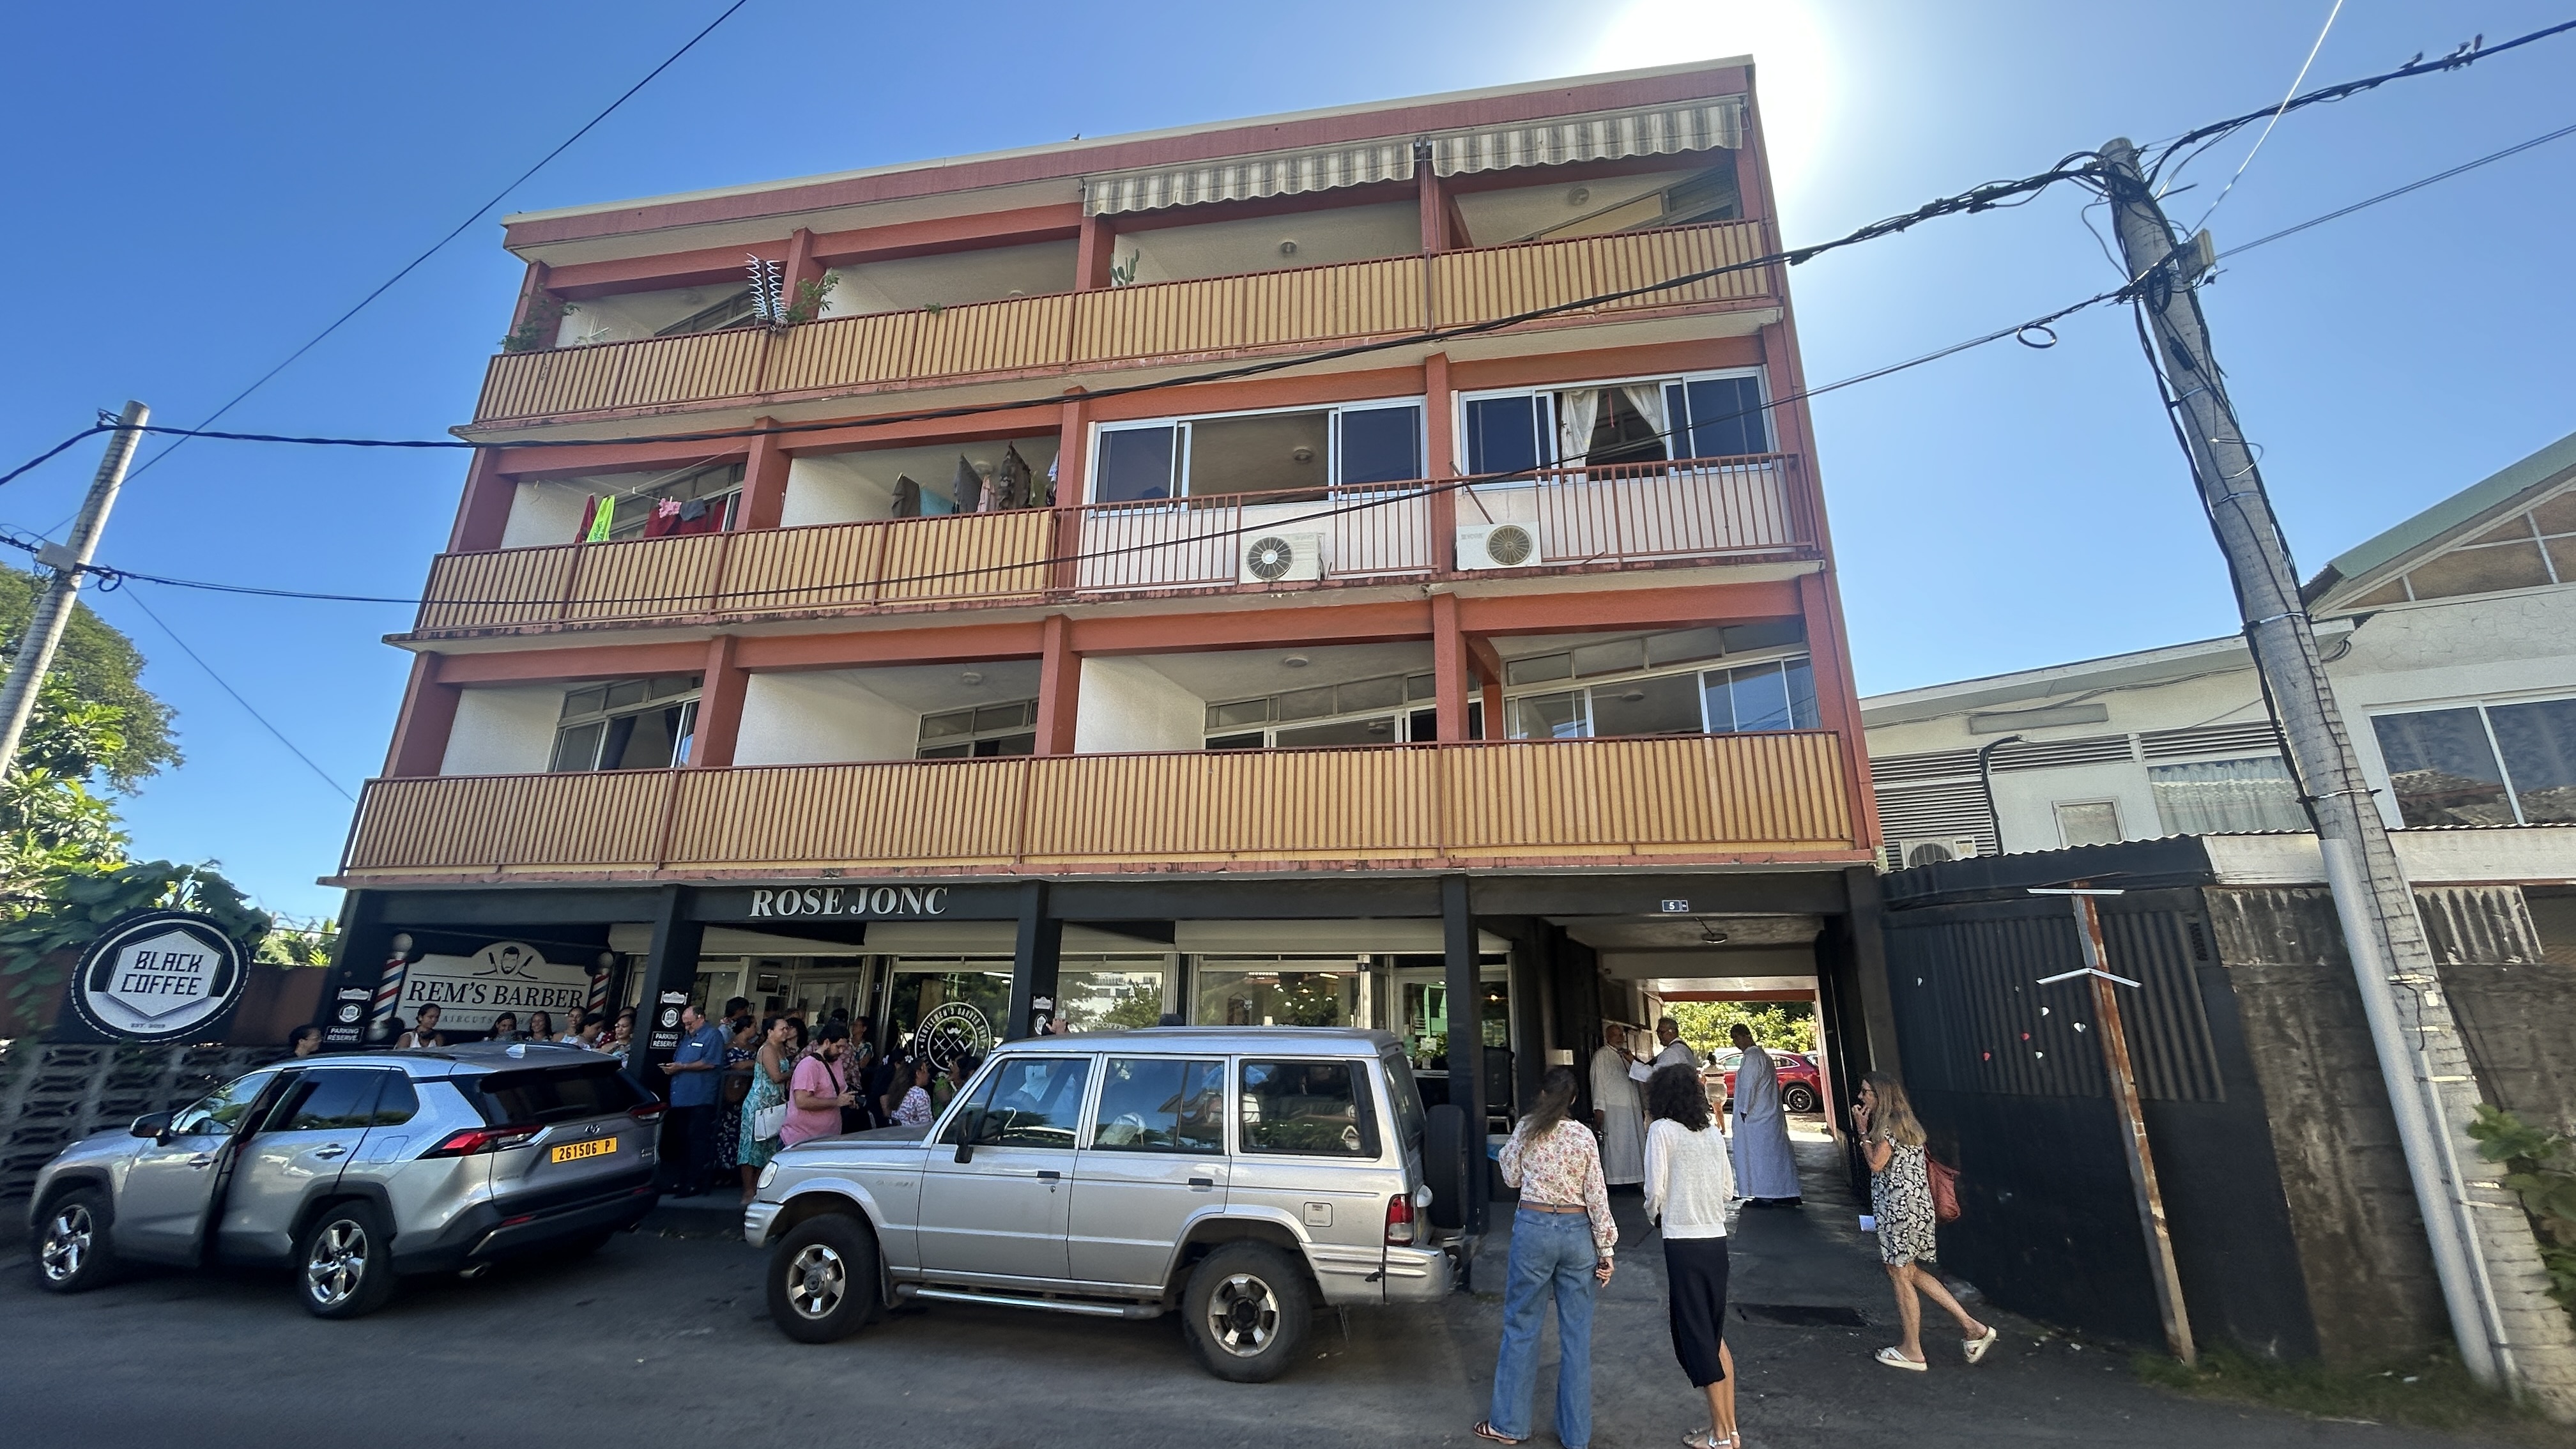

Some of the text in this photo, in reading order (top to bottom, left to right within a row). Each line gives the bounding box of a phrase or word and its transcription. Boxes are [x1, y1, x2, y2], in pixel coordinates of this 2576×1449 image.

[748, 887, 948, 917] ROSE JONC
[1669, 901, 1675, 910] 5
[134, 951, 204, 972] BLACK
[119, 974, 202, 995] COFFEE
[406, 980, 583, 1008] REM'S BARBER
[441, 1014, 493, 1023] AIRCUTS
[918, 1007, 954, 1043] GENTLEMEN'S
[559, 1140, 610, 1160] 261506 P
